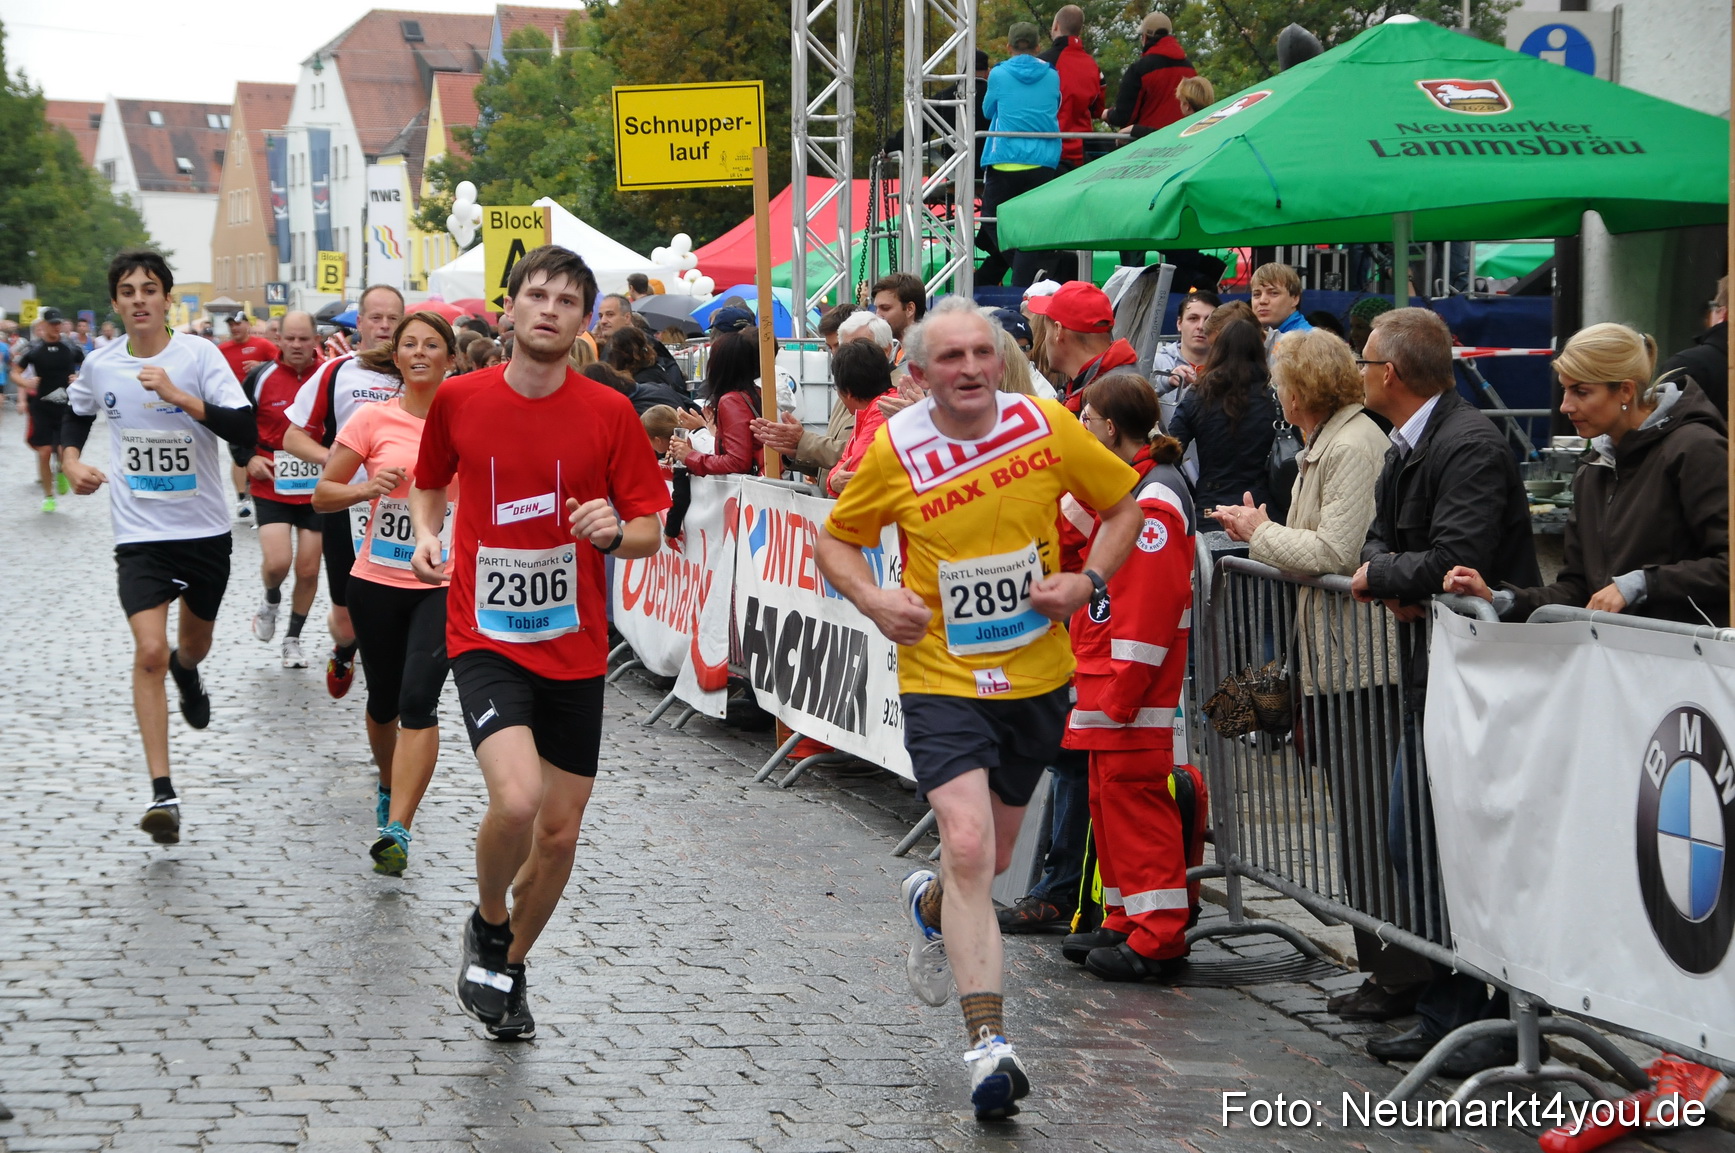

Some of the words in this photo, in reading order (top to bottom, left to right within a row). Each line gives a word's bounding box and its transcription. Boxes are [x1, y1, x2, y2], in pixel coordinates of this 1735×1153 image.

[624, 115, 752, 137] Schnupper-
[1394, 119, 1593, 135] Neumarkter
[669, 141, 710, 161] lauf
[1367, 135, 1648, 158] Lammsbräu
[490, 211, 544, 230] Block
[320, 252, 344, 261] Block
[324, 264, 339, 285] B
[127, 447, 190, 472] 3155
[280, 461, 319, 477] 2938
[131, 476, 175, 491] JONAS
[920, 479, 985, 522] MAX
[990, 447, 1062, 489] BÖGL
[512, 502, 539, 516] DEHN
[478, 556, 511, 567] PARTL
[513, 556, 560, 568] Neumarkt
[940, 570, 973, 581] PARTL
[975, 559, 1026, 577] Neumarkt
[487, 568, 568, 607] 2306
[950, 570, 1033, 619] 2894
[506, 615, 550, 630] Tobias
[975, 620, 1025, 641] Johann
[1644, 712, 1735, 806] BMW
